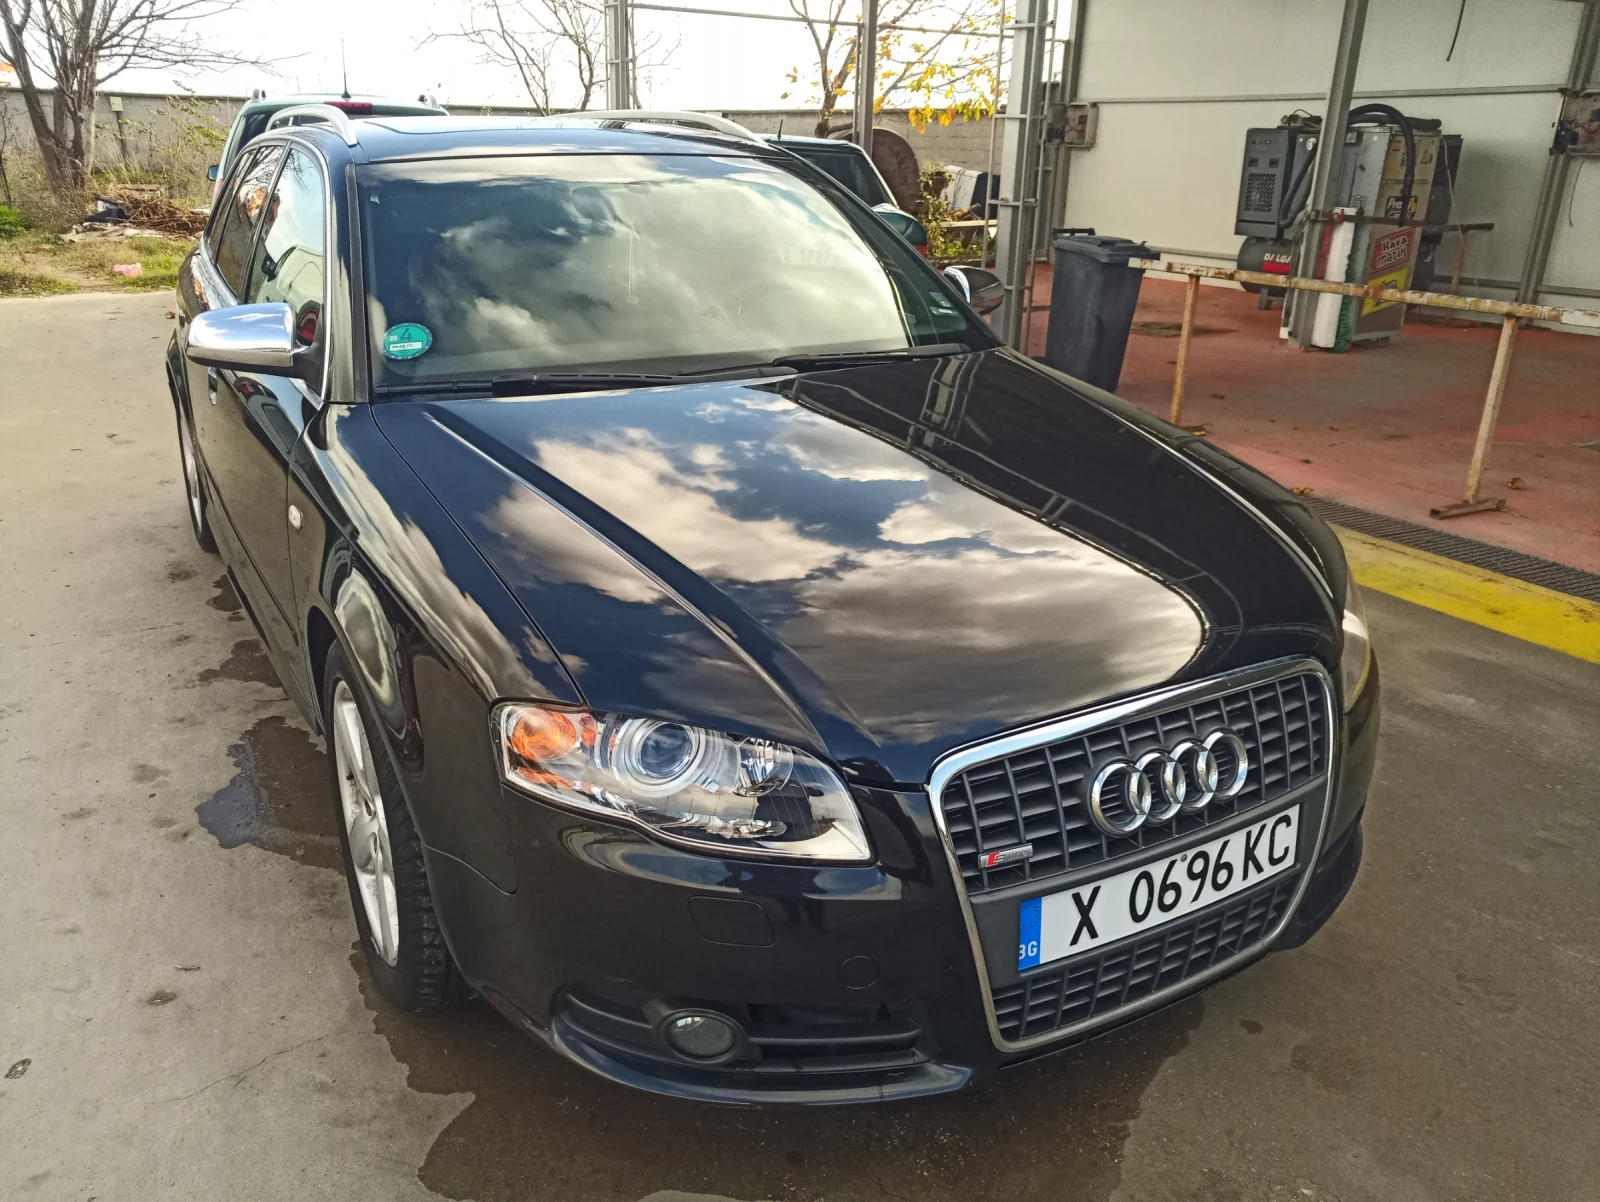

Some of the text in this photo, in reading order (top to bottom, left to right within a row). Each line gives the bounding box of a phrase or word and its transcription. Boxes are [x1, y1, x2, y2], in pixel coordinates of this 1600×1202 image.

[1382, 236, 1408, 252] Hava
[1377, 246, 1407, 268] matik
[400, 327, 412, 341] 4
[1069, 814, 1292, 946] X 0696 KC
